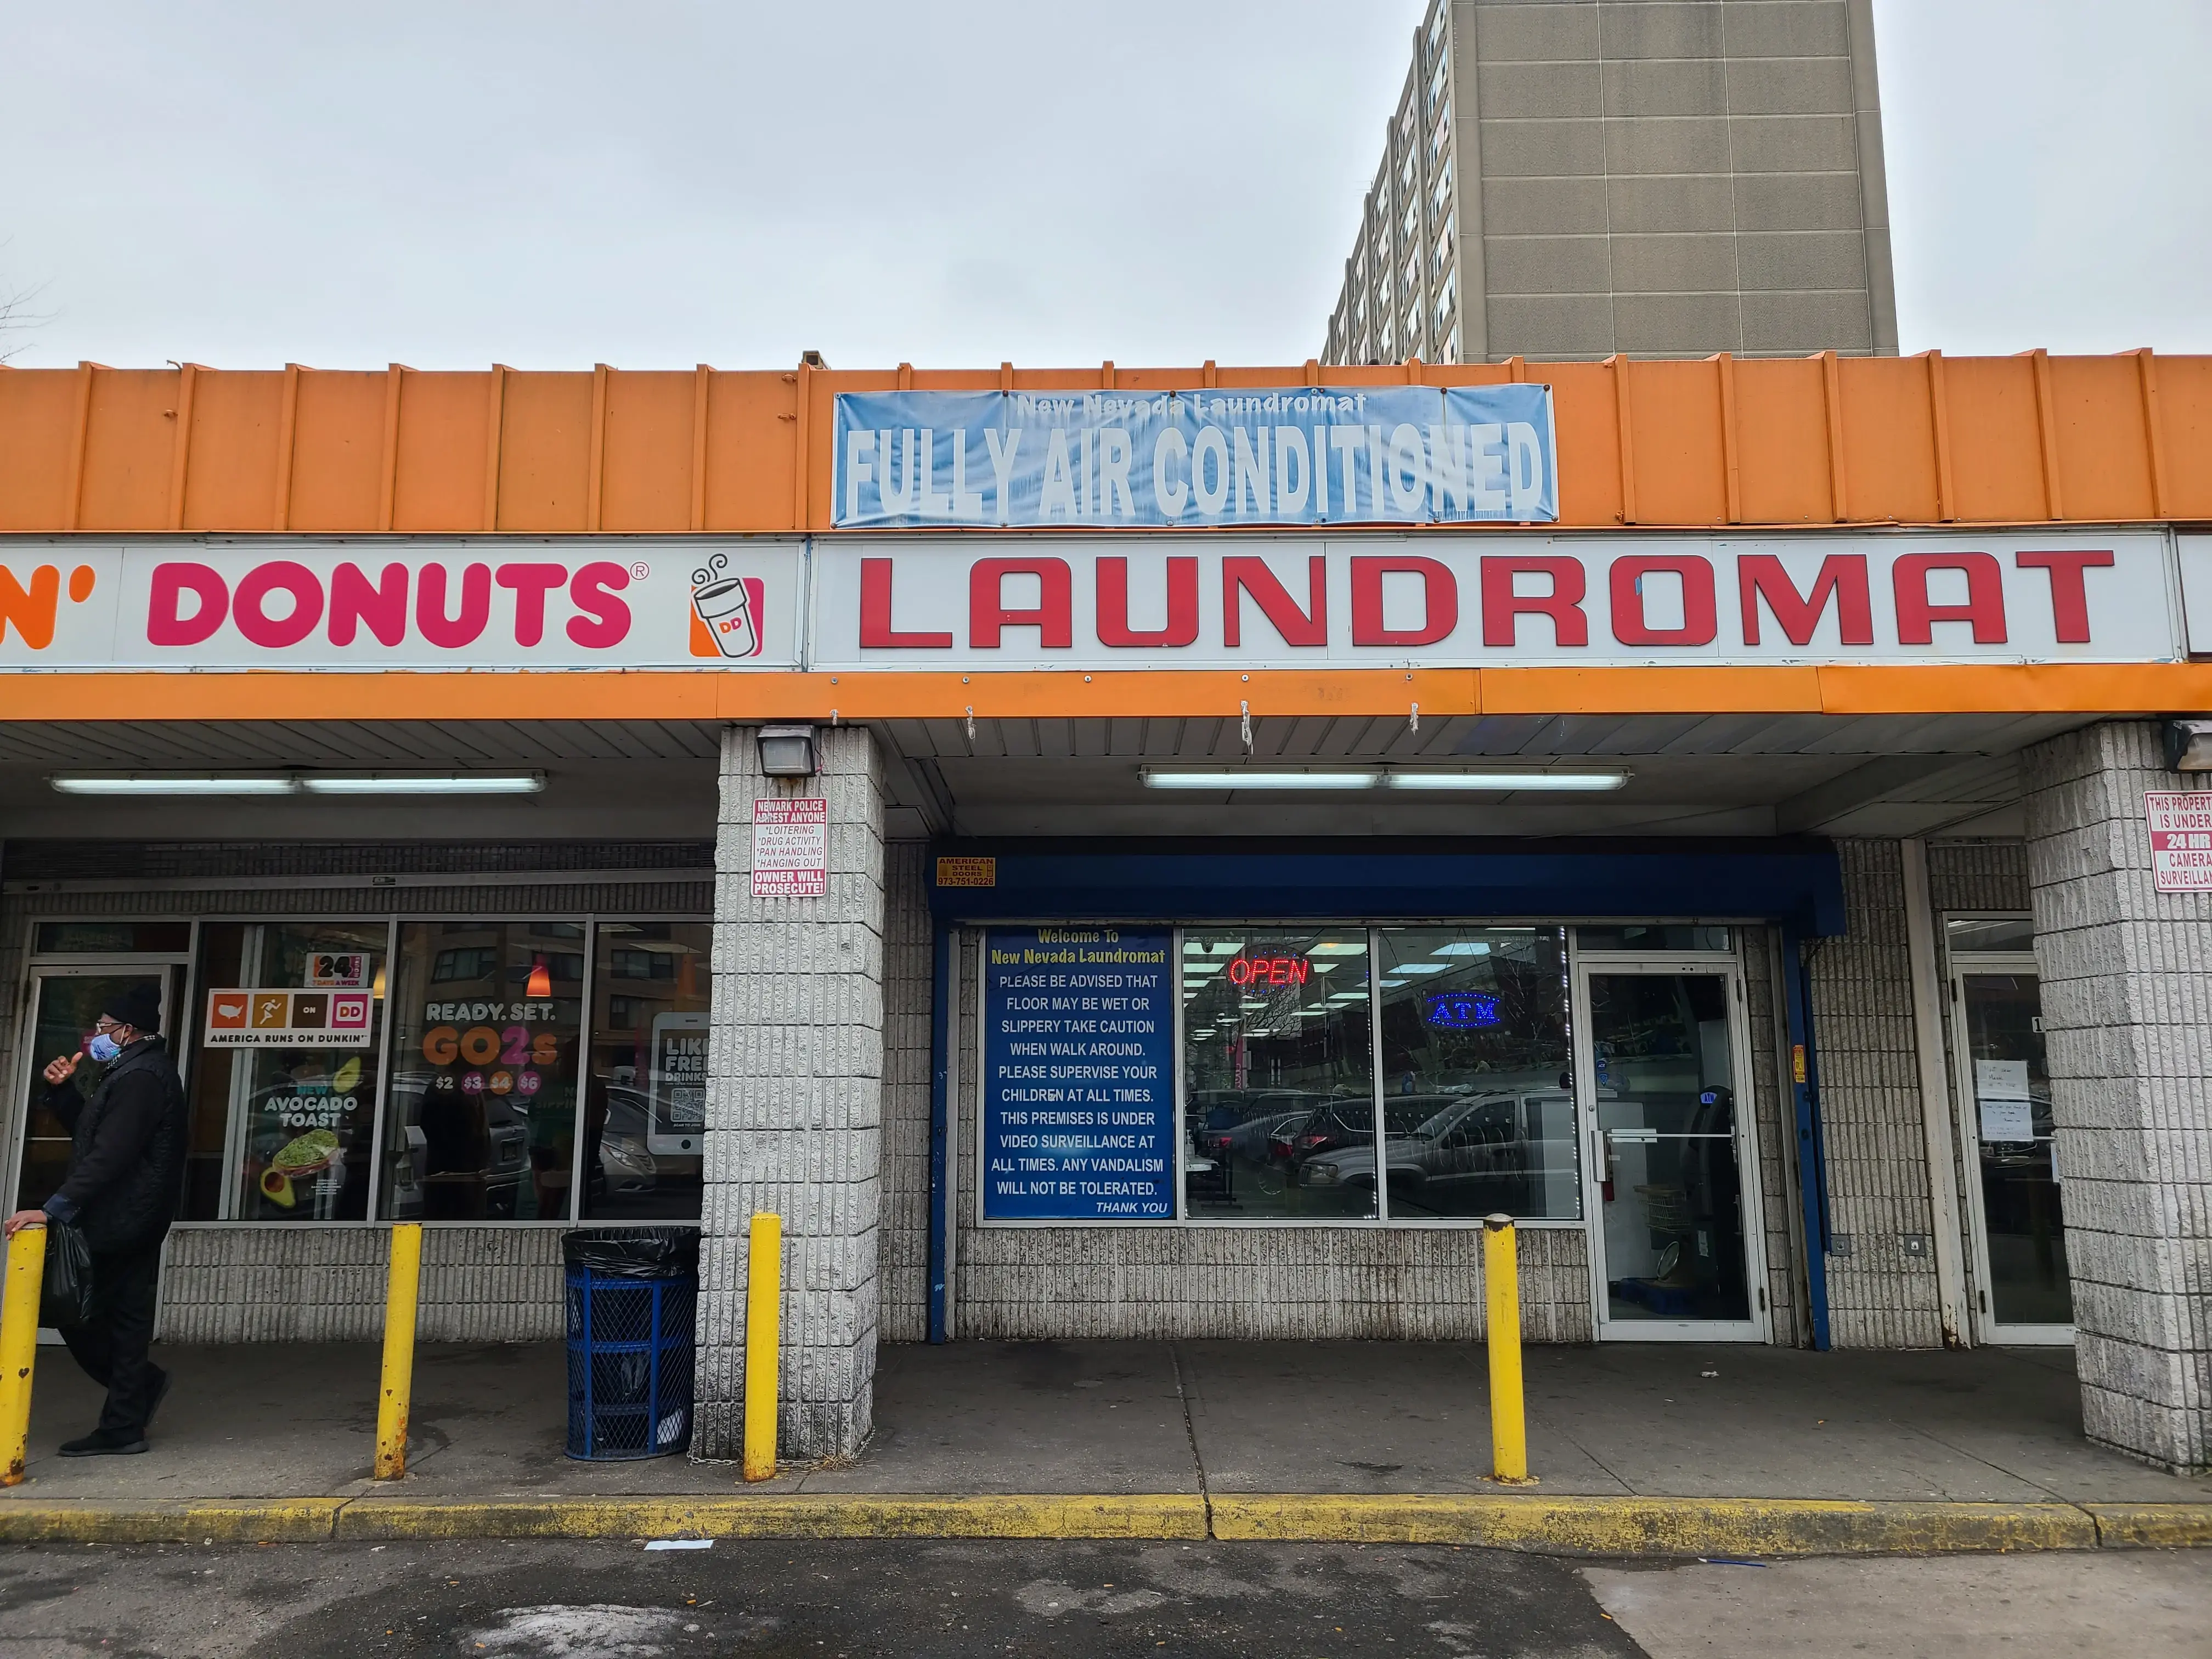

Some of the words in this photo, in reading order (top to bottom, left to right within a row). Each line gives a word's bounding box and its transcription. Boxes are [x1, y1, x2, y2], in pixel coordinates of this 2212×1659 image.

[1017, 394, 1073, 414] New
[1084, 394, 1186, 415] Nevada
[1194, 392, 1366, 415] Laundromat
[846, 427, 1021, 518] FULLY
[1039, 427, 1132, 516] AIR
[1154, 421, 1542, 516] CONDITIONED
[860, 550, 2115, 647] LAUNDROMAT
[719, 617, 742, 633] DD
[758, 800, 792, 812] NEWARK
[794, 800, 823, 811] POLICE
[2149, 797, 2169, 811] THIS
[2172, 797, 2212, 811] PROPERT
[755, 812, 788, 823] ARREST
[791, 812, 825, 822] ANYONE
[2160, 814, 2170, 828] IS
[2173, 814, 2212, 828] UNDER
[785, 836, 821, 845] ACTIVITY
[2167, 833, 2187, 849] 24
[2188, 833, 2210, 849] HR
[778, 847, 823, 856] HANDLING
[803, 858, 822, 867] OUT
[2169, 853, 2212, 867] CAMERA
[755, 871, 794, 883] OWNER
[797, 871, 823, 882] WILL
[938, 877, 994, 885] 973-751-0226
[754, 883, 823, 894] PROSECUTE!
[1037, 928, 1099, 944] Welcome
[1104, 929, 1119, 943] To
[991, 949, 1020, 964] New
[1024, 949, 1075, 964] Nevada
[1079, 948, 1165, 963] Laundromat
[318, 956, 352, 978] 24
[1229, 958, 1309, 984] OPEN
[1000, 975, 1046, 988] PLEASE
[1050, 975, 1066, 988] BE
[1069, 975, 1122, 988] ADVISED
[1126, 975, 1158, 988] THAT
[1007, 997, 1048, 1010] FLOOR
[1052, 997, 1079, 1010] MAY
[1082, 997, 1098, 1010] BE
[1102, 997, 1128, 1010] WET
[1131, 997, 1149, 1011] OR
[1433, 1002, 1496, 1019] ATM
[340, 1006, 360, 1017] DD
[426, 1003, 506, 1020] READY.
[510, 1003, 556, 1020] SET.
[1001, 1020, 1060, 1033] SLIPPERY
[1064, 1020, 1097, 1032] TAKE
[1100, 1020, 1154, 1033] CAUTION
[1010, 1043, 1046, 1056] WHEN
[1050, 1043, 1086, 1056] WALK
[1090, 1043, 1145, 1056] AROUND.
[665, 1073, 708, 1081] DRINKS
[998, 1066, 1046, 1079] PLEASE
[1050, 1066, 1119, 1079] SUPERVISE
[1122, 1066, 1157, 1079] YOUR
[436, 1076, 453, 1090] $2
[464, 1076, 482, 1090] $3
[491, 1076, 510, 1090] $4
[520, 1076, 538, 1090] $6
[297, 1086, 328, 1094] NEW
[1002, 1089, 1063, 1102] CHILDREN
[1067, 1089, 1083, 1102] AT
[1086, 1089, 1110, 1102] ALL
[1113, 1089, 1154, 1102] TIMES.
[264, 1097, 357, 1110] AVOCADO
[279, 1113, 341, 1127] TOAST
[1001, 1112, 1028, 1125] THIS
[1031, 1112, 1093, 1125] PREMISES
[1097, 1113, 1108, 1125] IS
[1112, 1113, 1155, 1125] UNDER
[1000, 1135, 1038, 1148] VIDEO
[1041, 1135, 1135, 1148] SURVEILLANCE
[1138, 1136, 1155, 1148] AT
[991, 1159, 1015, 1171] ALL
[1018, 1159, 1058, 1172] TIMES.
[1062, 1159, 1088, 1172] ANY
[1091, 1159, 1163, 1172] VANDALISM
[997, 1182, 1026, 1194] WILL
[1030, 1182, 1056, 1195] NOT
[1060, 1182, 1076, 1195] BE
[1079, 1182, 1157, 1195] TOLERATED.
[1097, 1203, 1138, 1213] THANK
[1142, 1203, 1167, 1213] YOU
